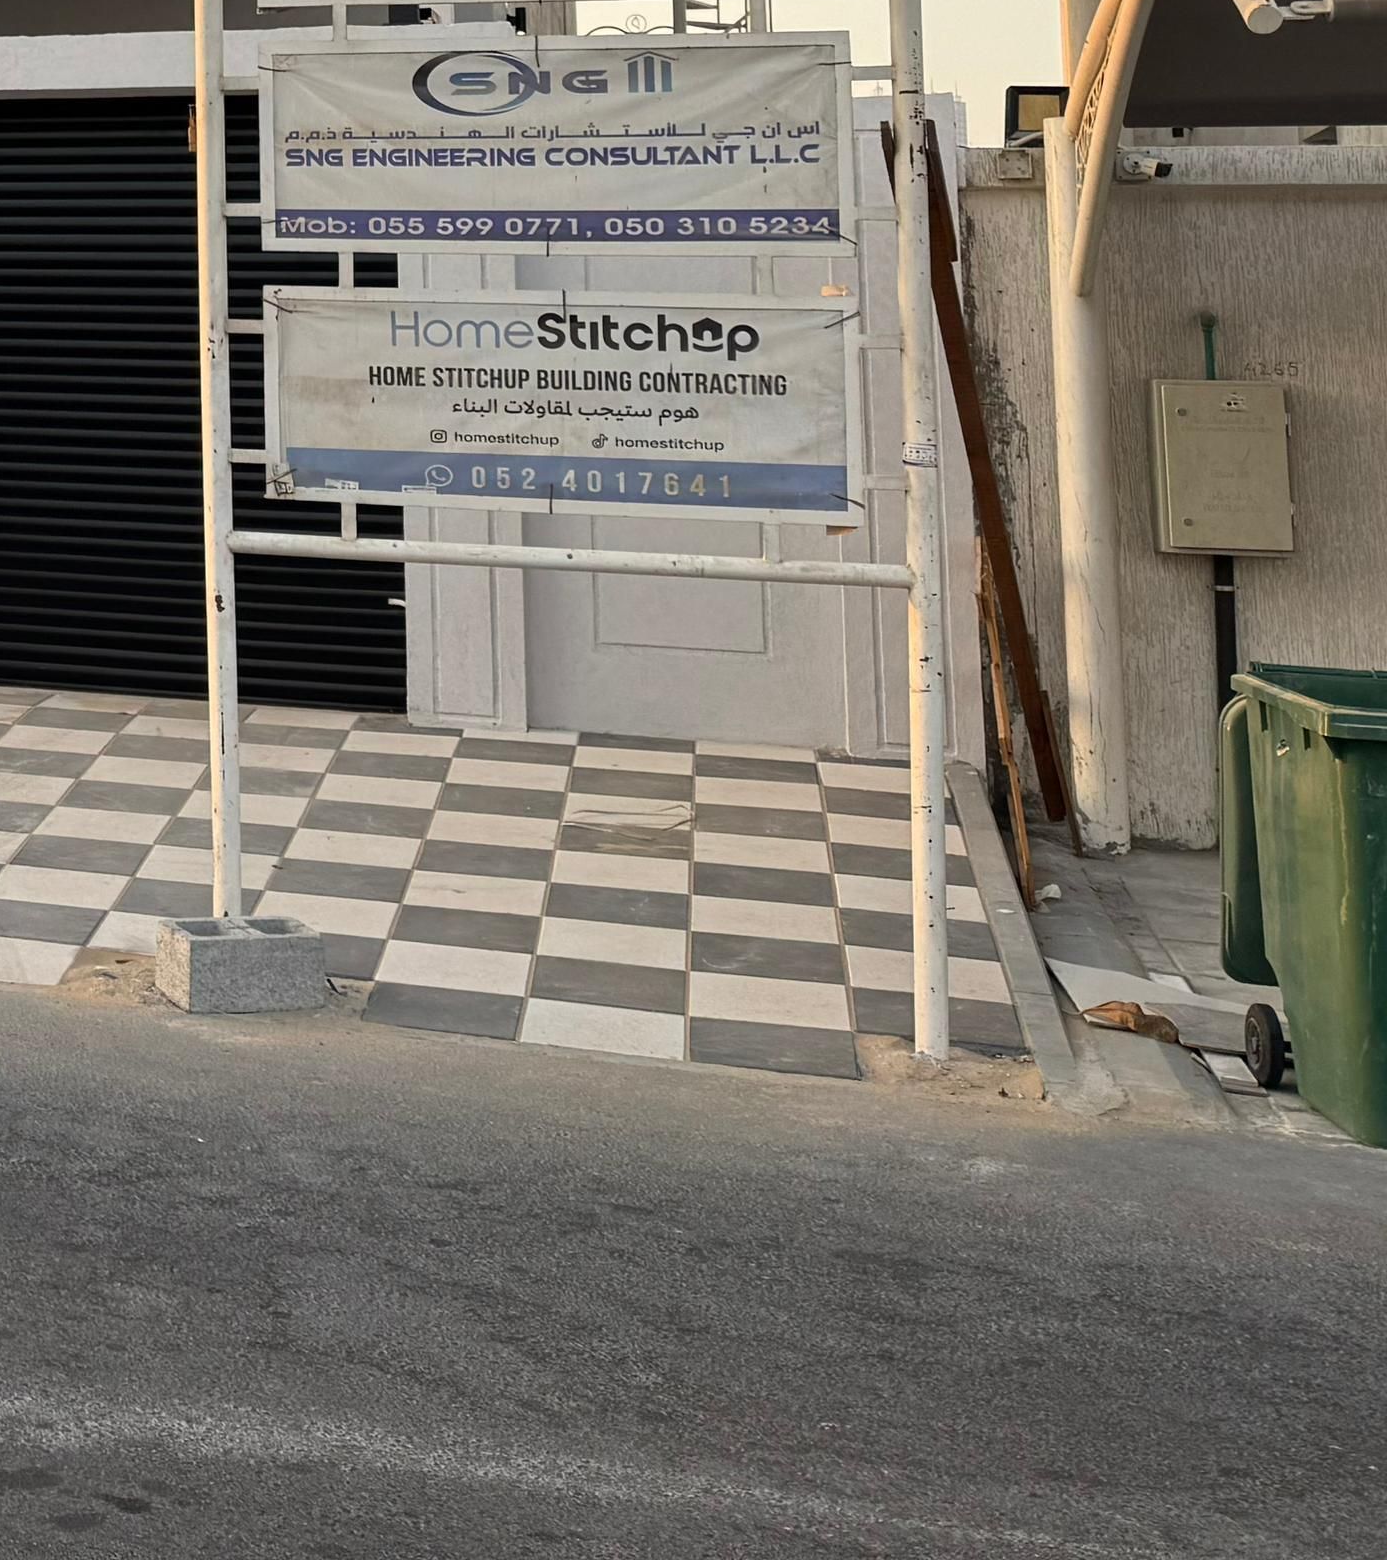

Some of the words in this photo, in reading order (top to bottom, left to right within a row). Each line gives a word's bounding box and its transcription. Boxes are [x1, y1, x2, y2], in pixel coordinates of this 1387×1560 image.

[448, 69, 609, 96] SNG
[341, 125, 516, 144] الهندسية
[711, 125, 756, 144] جي
[760, 121, 782, 139] ان
[786, 120, 821, 139] اس
[284, 147, 344, 168] SNG
[351, 146, 536, 168] ENGINEERING
[544, 144, 742, 167] CONSULTANT
[749, 143, 821, 165] L.L.C
[279, 215, 356, 235] Mob:
[367, 216, 426, 236] 055
[435, 216, 494, 236] 599
[504, 216, 593, 238] 0771,
[603, 216, 666, 237] 050
[676, 215, 738, 237] 310
[747, 214, 832, 237] 5234
[368, 365, 427, 387] HOME
[432, 366, 531, 390] STITCHUP
[536, 368, 633, 392] BUILDING
[638, 370, 788, 397] CONTRACTING
[452, 397, 498, 418] البناء
[503, 399, 573, 419] لمقاولات
[577, 404, 653, 422] ستيجب
[657, 405, 700, 427] هوم
[453, 431, 560, 448] homestitchup
[614, 436, 726, 453] homestitchup
[470, 465, 536, 490] 052
[561, 468, 731, 498] 4017641
